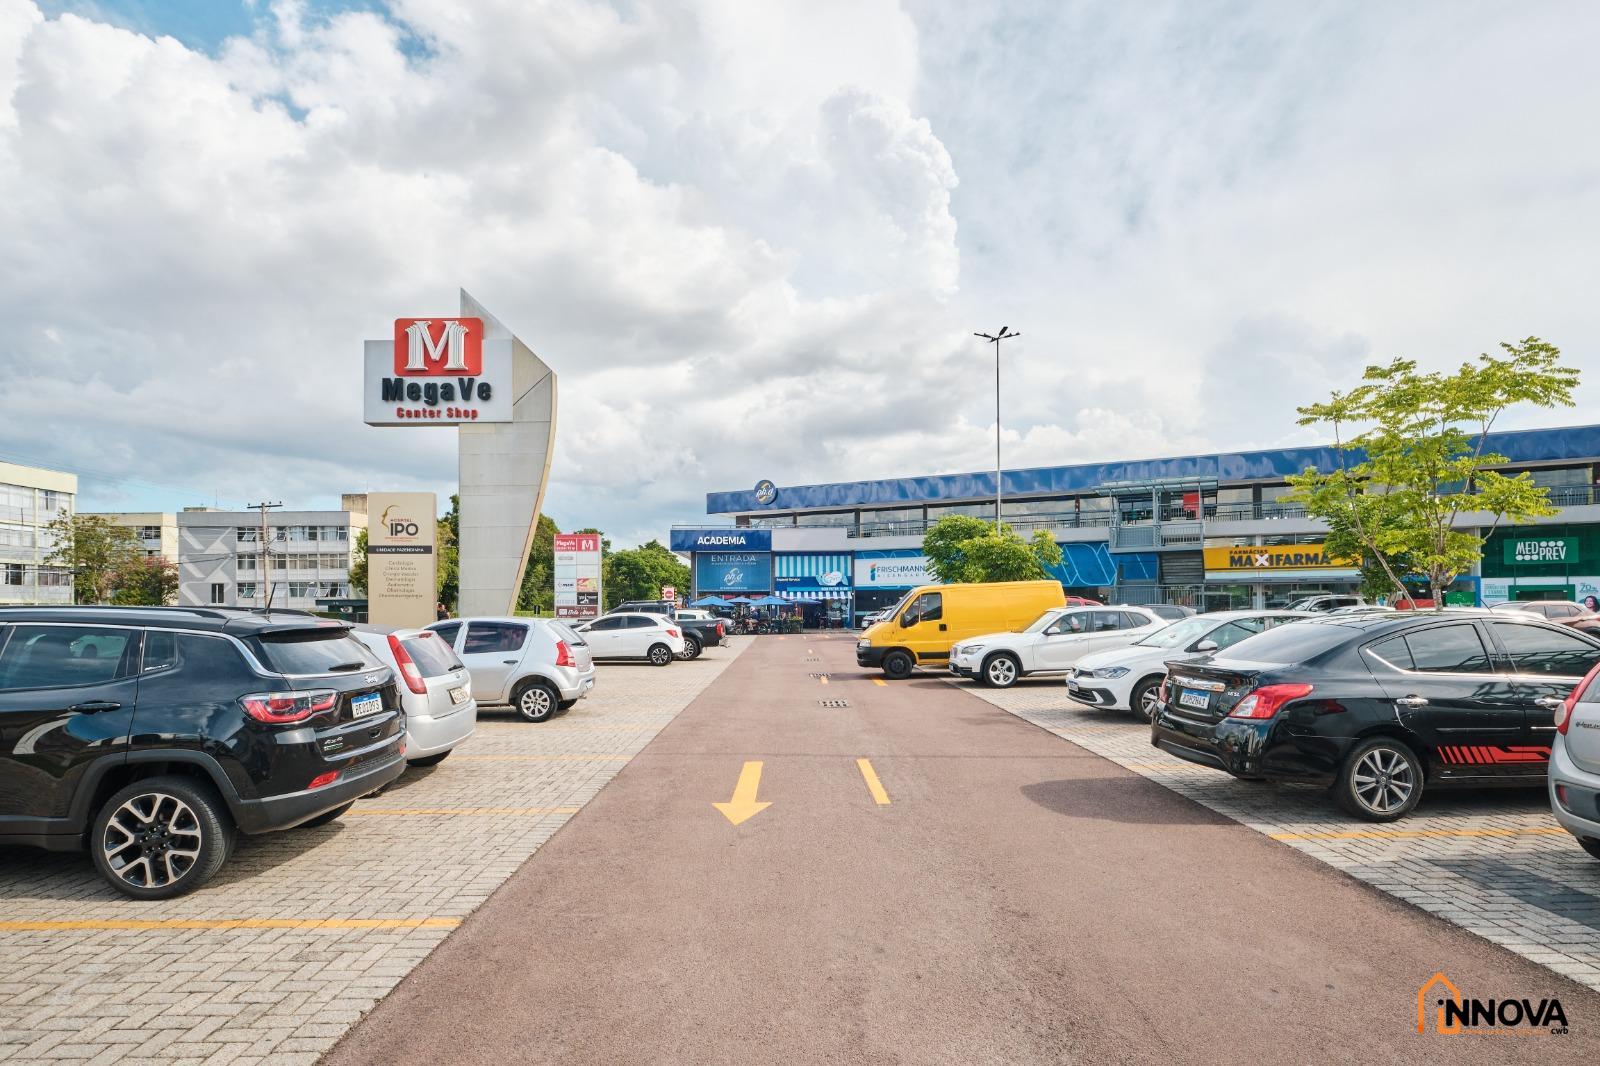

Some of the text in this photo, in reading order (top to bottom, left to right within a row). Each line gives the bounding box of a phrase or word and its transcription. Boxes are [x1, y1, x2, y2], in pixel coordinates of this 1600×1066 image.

[405, 320, 469, 372] M
[381, 377, 492, 406] MegaVe
[396, 407, 479, 420] Center Shop
[390, 522, 419, 536] IPO
[697, 536, 746, 545] ACADEMIA
[1515, 541, 1539, 555] MED
[1539, 546, 1567, 561] PREV
[711, 554, 757, 562] ENTRADA
[1229, 552, 1331, 567] MAXIFARMA
[876, 565, 926, 573] FRISCHMANN
